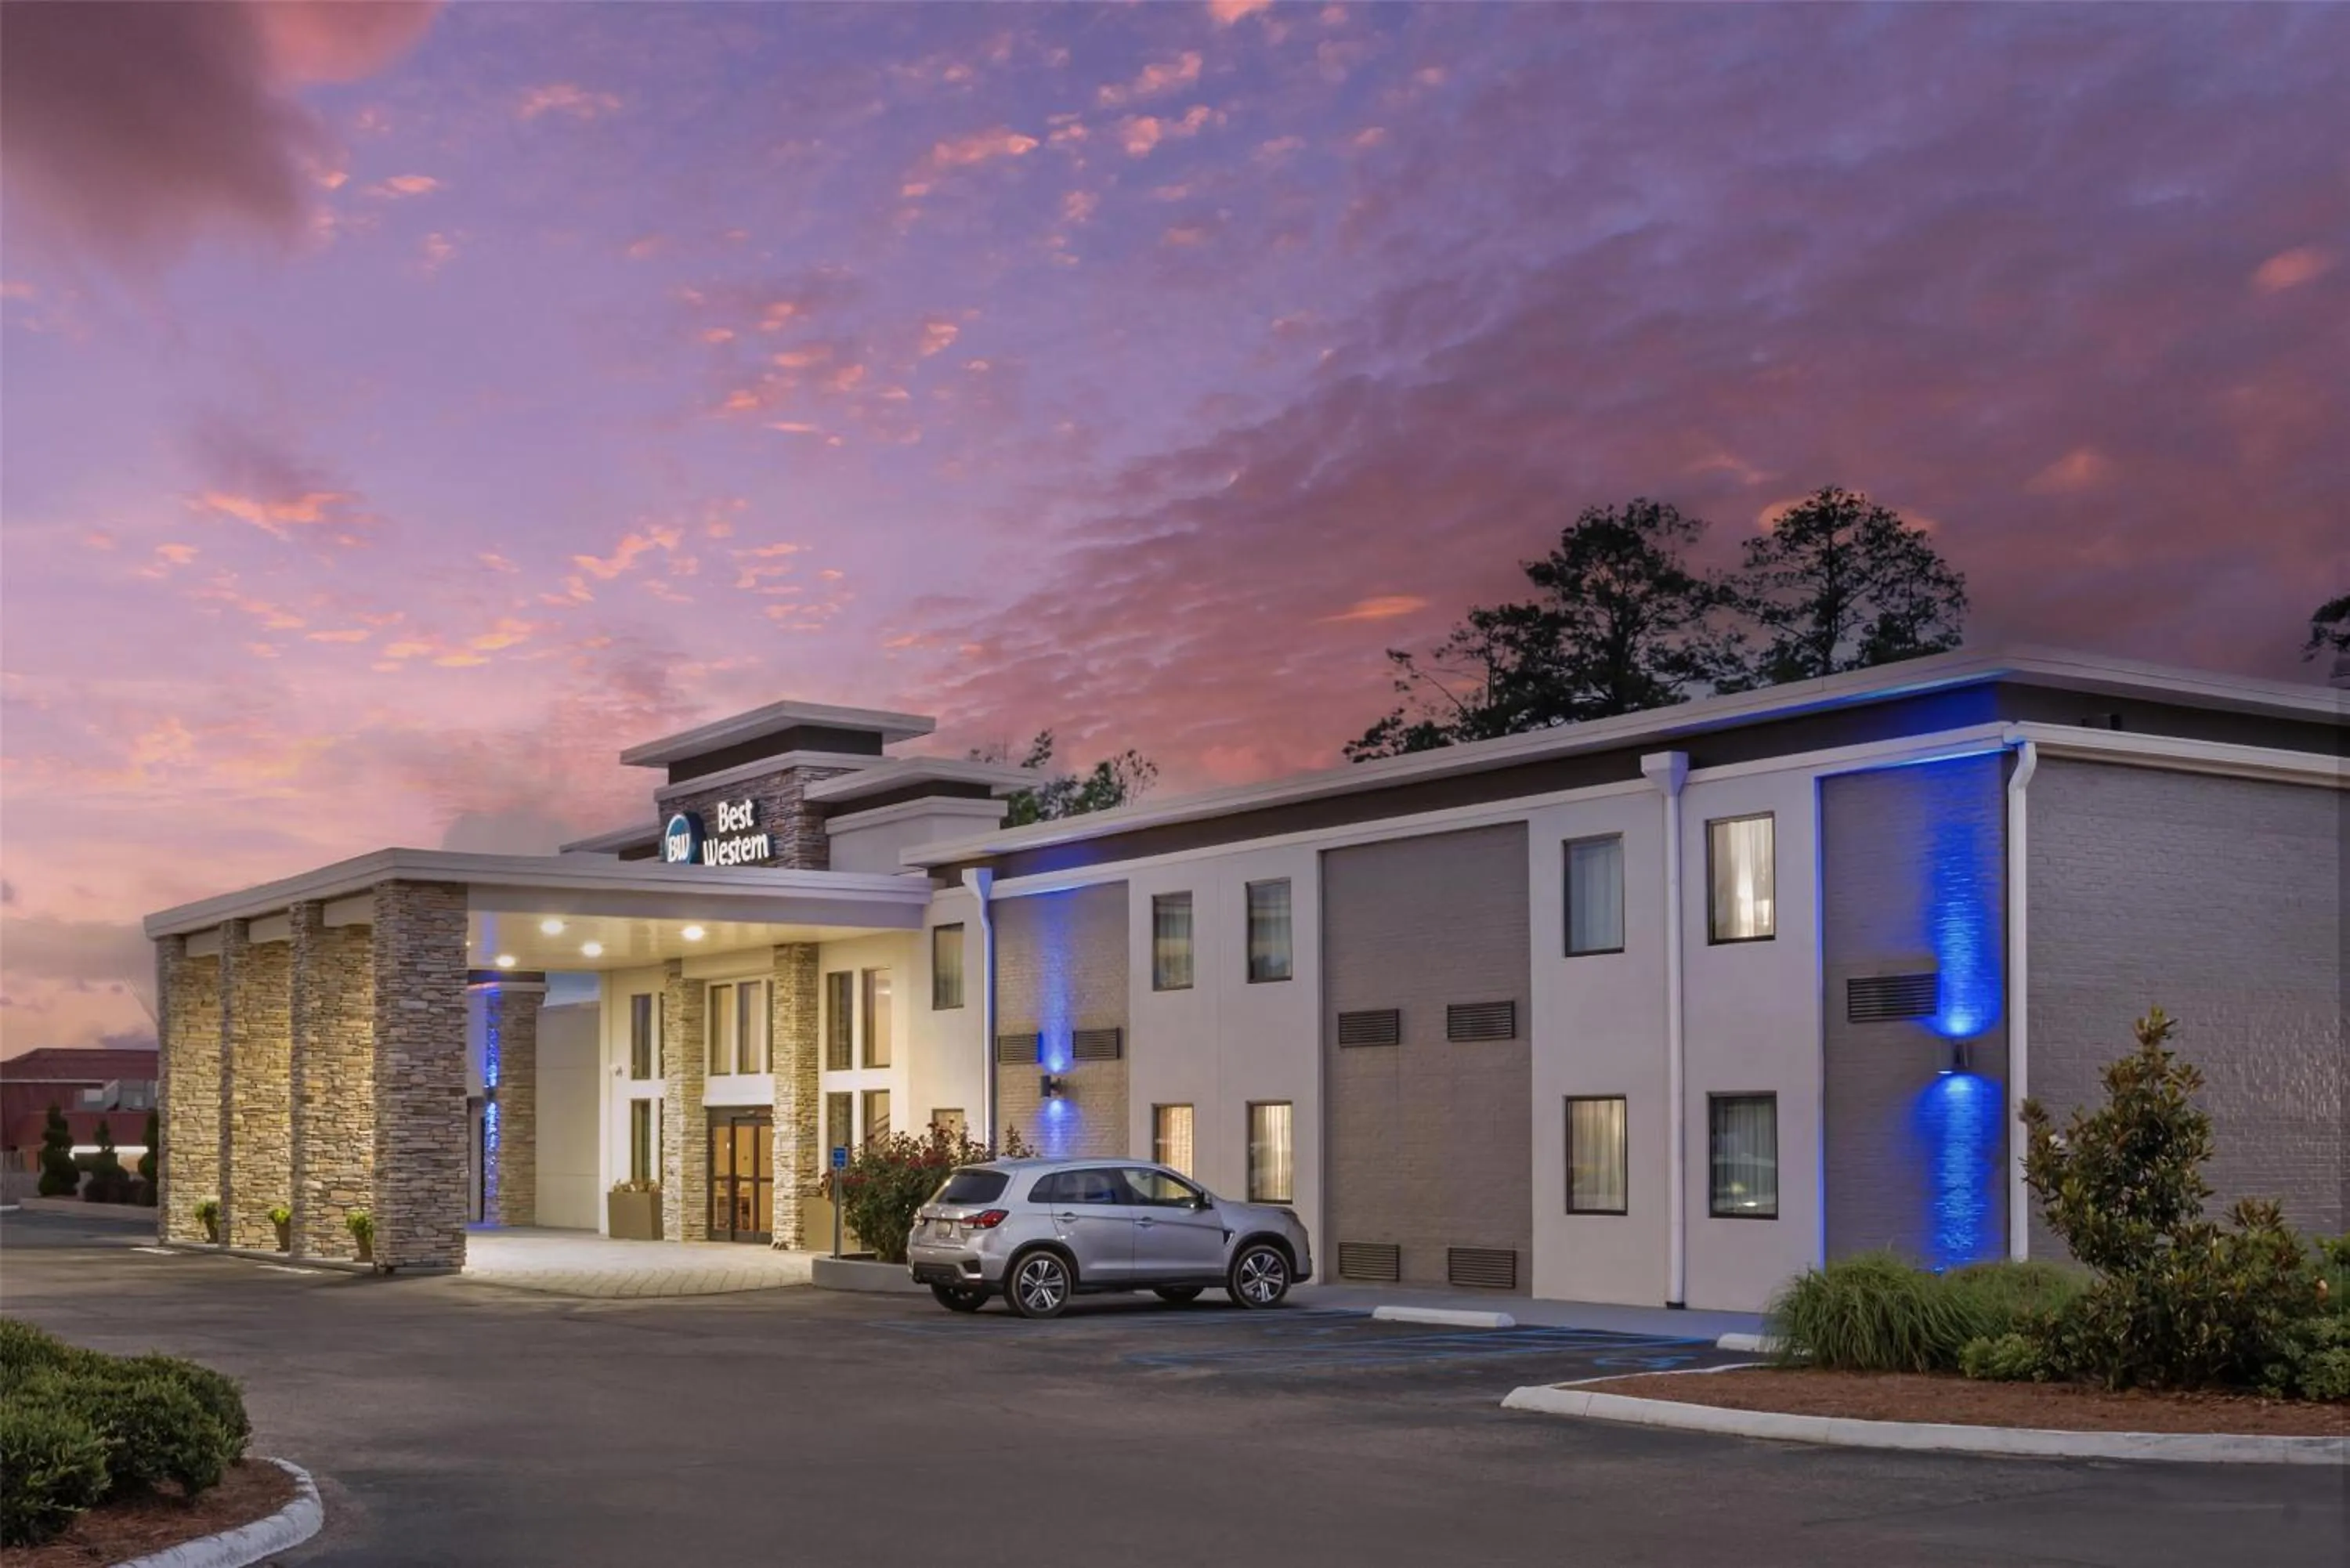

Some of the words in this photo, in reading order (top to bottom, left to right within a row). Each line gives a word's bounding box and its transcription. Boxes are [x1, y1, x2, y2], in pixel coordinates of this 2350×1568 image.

[718, 799, 754, 833] Best
[667, 833, 689, 862] BW
[703, 834, 768, 865] Western
